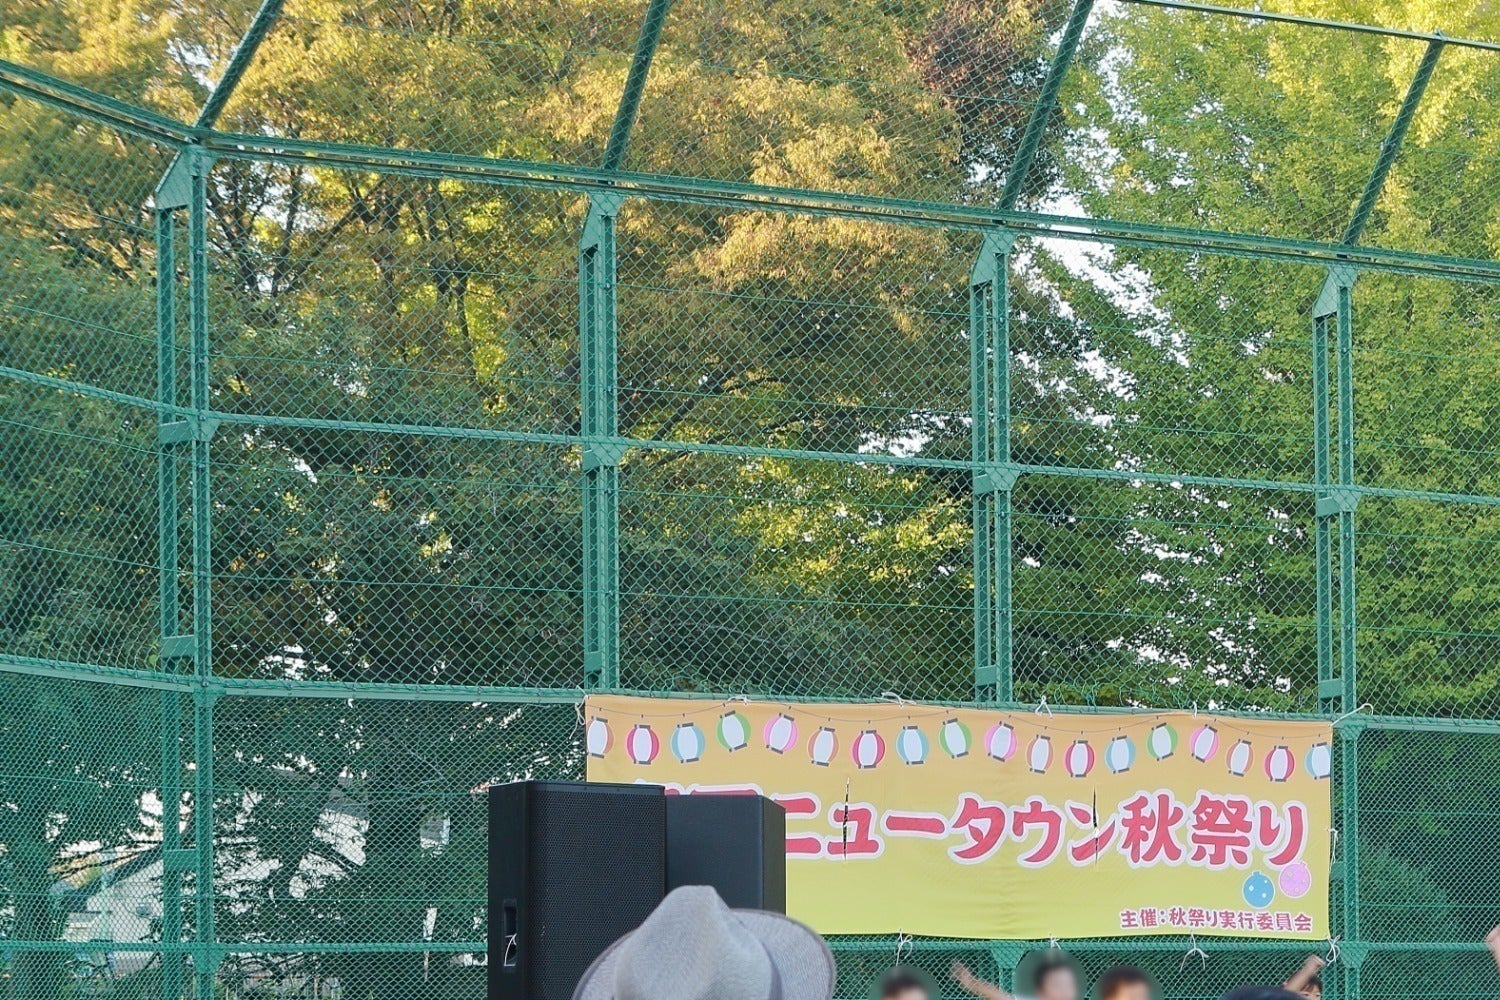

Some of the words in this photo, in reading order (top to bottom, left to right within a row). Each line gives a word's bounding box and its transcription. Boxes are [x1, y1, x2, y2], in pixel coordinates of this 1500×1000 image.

[662, 787, 1304, 866] ニュータウン秋祭り
[1120, 907, 1312, 931] 主催：秋祭り実行委員会
